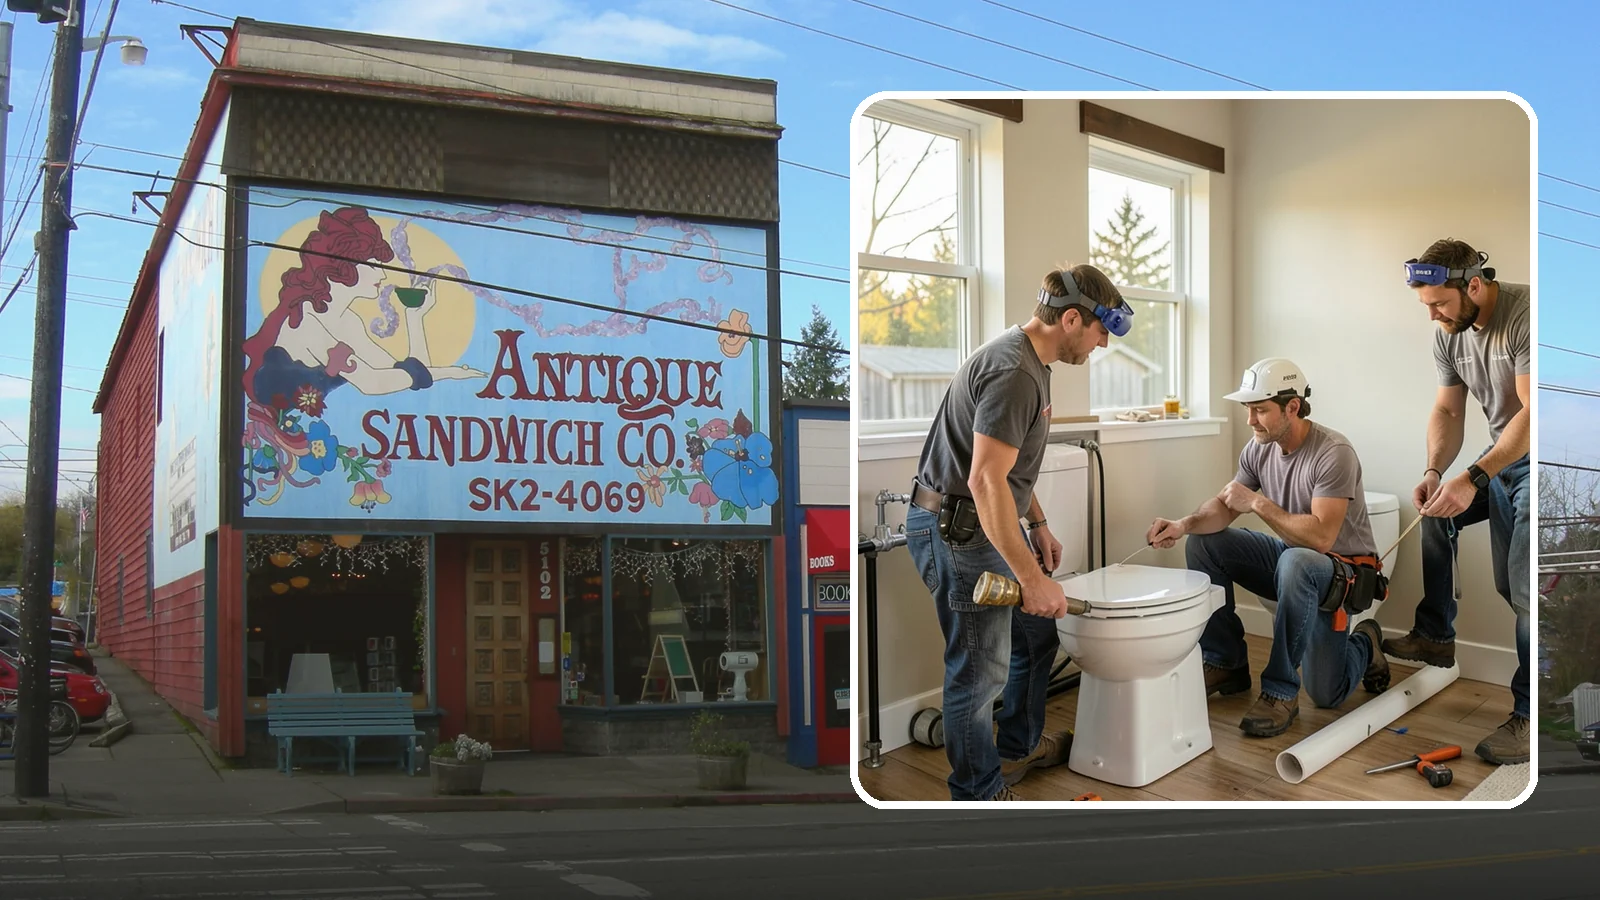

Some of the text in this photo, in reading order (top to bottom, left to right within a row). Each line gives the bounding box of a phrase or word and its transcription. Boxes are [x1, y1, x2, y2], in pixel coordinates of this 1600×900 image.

[475, 328, 724, 421] ANTIQUE
[361, 408, 686, 469] SANDWICH CO.
[468, 477, 646, 514] SK2-4069
[540, 541, 552, 600] 5102
[809, 555, 835, 569] BOOKS
